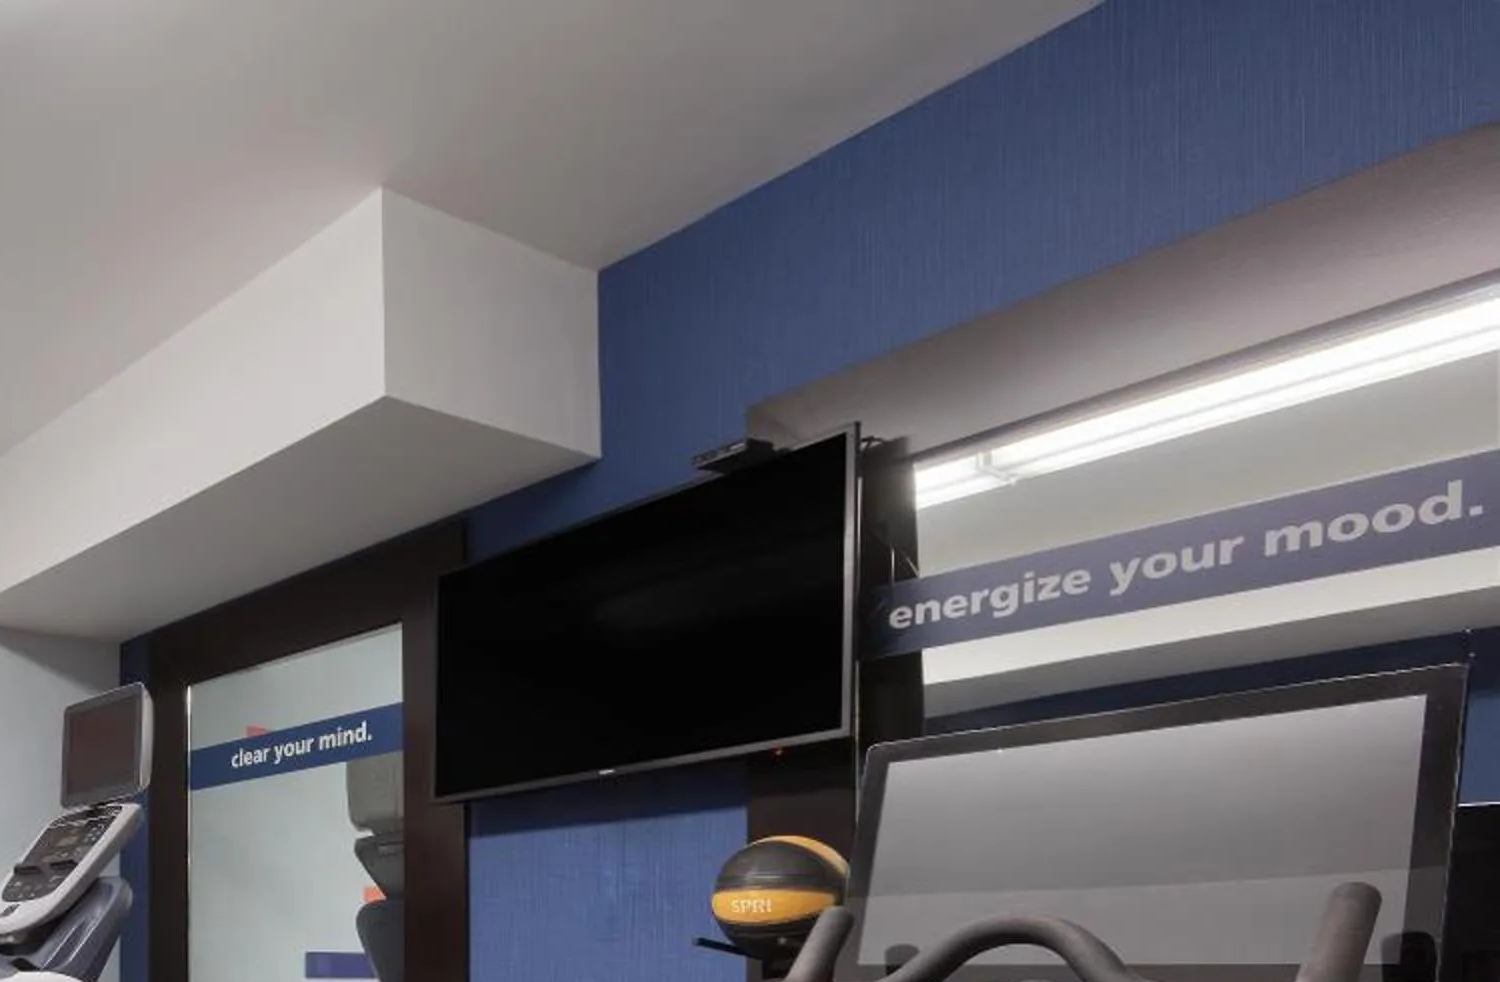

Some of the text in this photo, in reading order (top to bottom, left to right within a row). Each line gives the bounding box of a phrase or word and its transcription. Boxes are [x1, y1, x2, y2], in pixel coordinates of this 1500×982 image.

[888, 479, 1484, 629] energize your mood.
[231, 720, 373, 768] clear your mind.
[729, 897, 773, 914] SPRI
